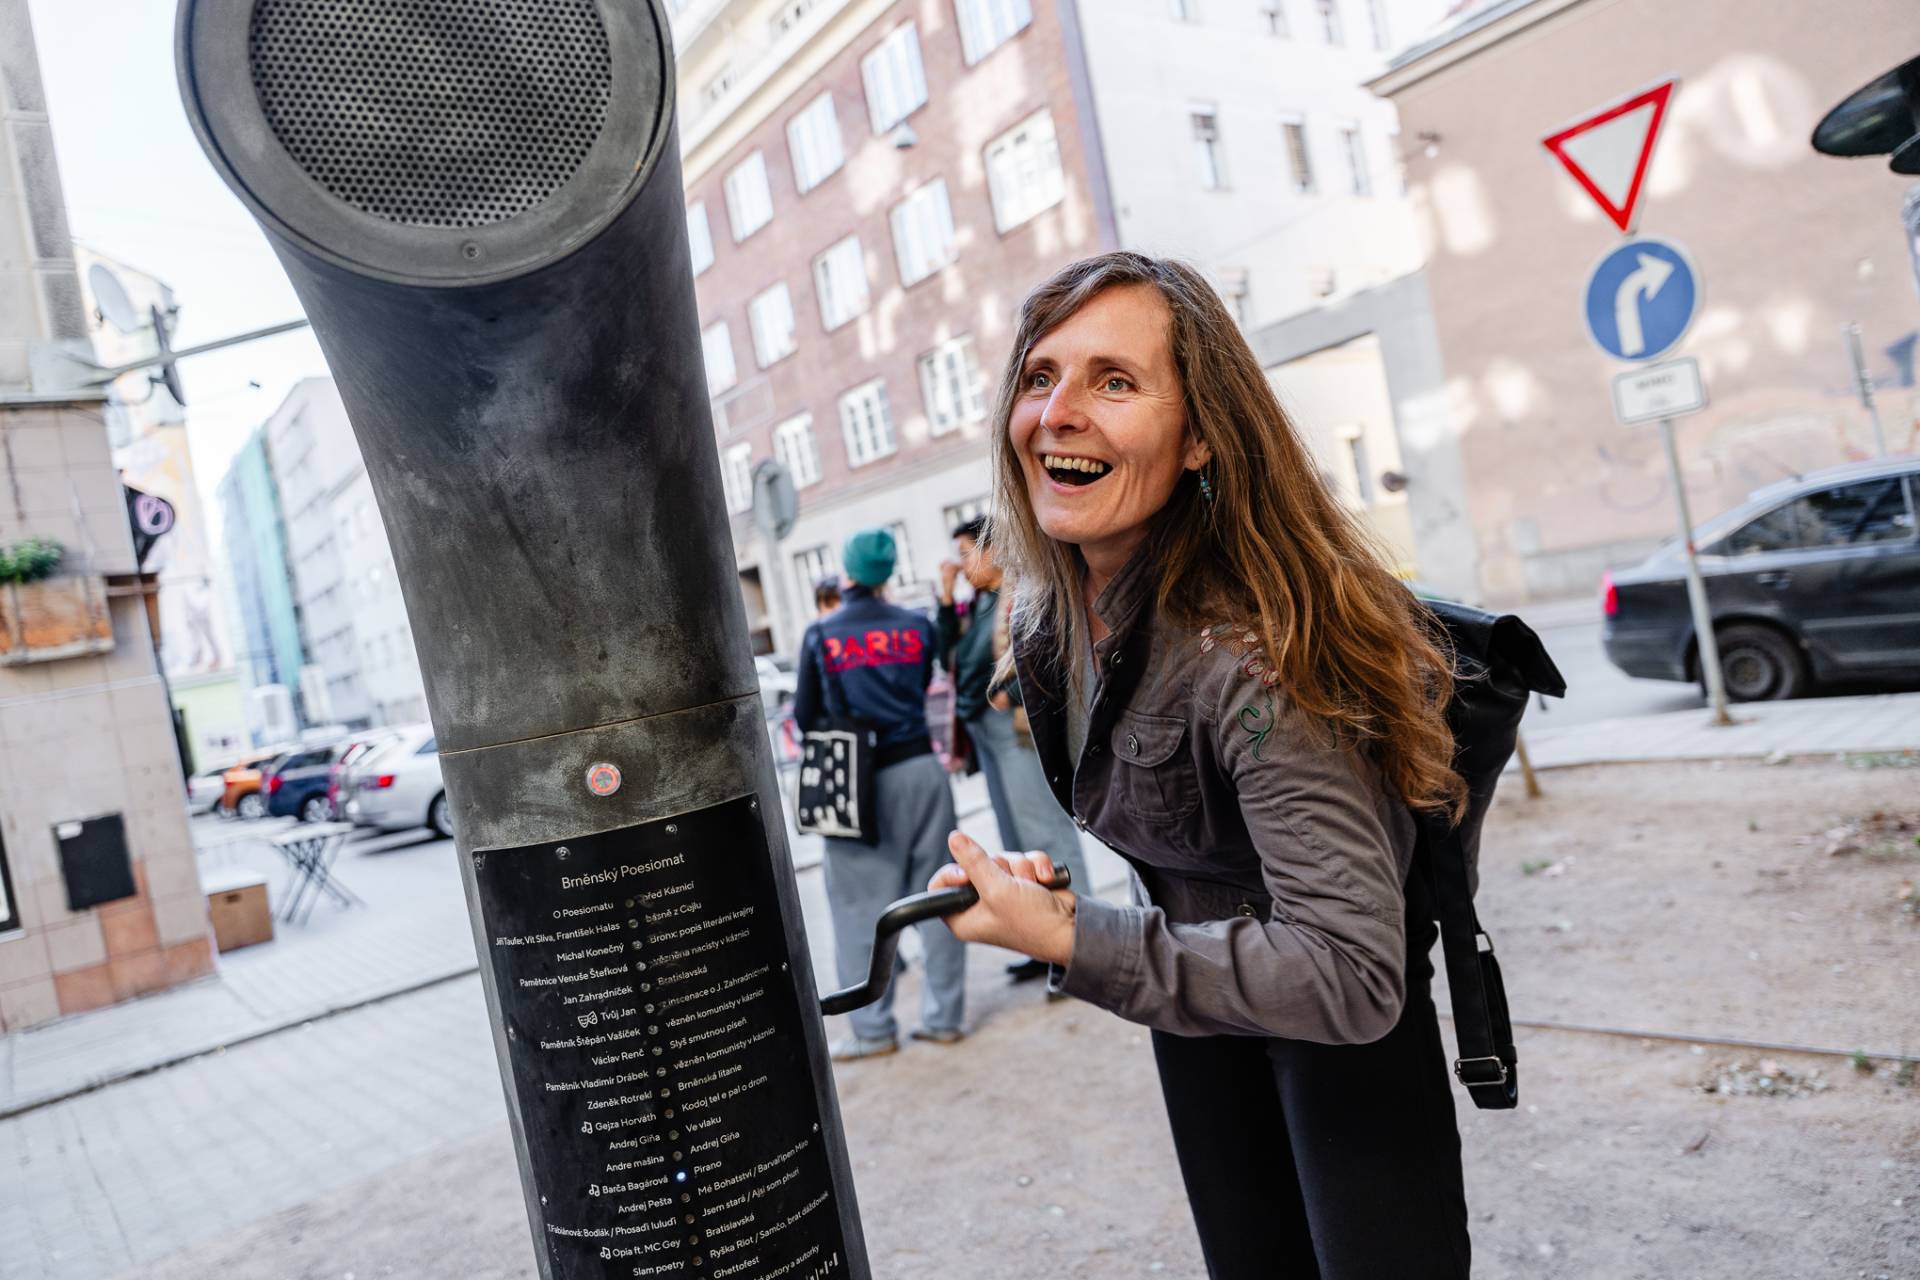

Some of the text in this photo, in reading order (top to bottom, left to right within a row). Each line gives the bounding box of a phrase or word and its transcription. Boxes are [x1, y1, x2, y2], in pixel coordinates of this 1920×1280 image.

[824, 627, 923, 662] PARIS
[562, 852, 685, 889] Brněnský Poesiomat
[553, 902, 614, 919] O Poesiomatu
[673, 907, 679, 916] z
[679, 923, 702, 938] popis
[702, 913, 732, 929] literární
[732, 904, 755, 920] krajiny
[556, 926, 595, 941] František
[595, 922, 621, 934] Halas
[557, 942, 625, 962] Michal Konečný
[691, 938, 720, 956] nacisty
[720, 937, 725, 945] v
[520, 963, 629, 988] Pamětnice Venuše Štefková
[657, 964, 708, 986] Bratislavská
[563, 985, 633, 1006] Jan Zahradníček
[709, 986, 716, 994] o
[715, 983, 723, 993] J.
[600, 1008, 637, 1023] Tvůj Jan
[666, 1014, 696, 1029] vězněn
[696, 999, 736, 1018] komunisty
[736, 998, 742, 1006] v
[540, 1028, 641, 1050] Pamětník Štěpán Vašíček
[669, 1016, 748, 1050] Slyš smutnou píseň
[592, 1048, 645, 1066] Václav Renč
[673, 1055, 706, 1071] vězněn
[706, 1040, 747, 1060] komunisty
[747, 1037, 753, 1045] v
[545, 1070, 649, 1092] Pamětník Vladimír Drábek
[677, 1063, 743, 1092] Brněnská litanie
[587, 1090, 653, 1110] Zdeněk Rotrekl
[682, 1074, 768, 1113] Kodoj tel e pal o drom
[595, 1112, 657, 1132] Gejza Horváth
[685, 1115, 722, 1133] Ve vlaku
[609, 1133, 661, 1150] Andrej Giňa
[690, 1130, 741, 1155] Andrej Giňa
[606, 1155, 665, 1173] Andre mašina
[693, 1160, 722, 1175] Pirano
[602, 1174, 669, 1195] Barča Bagárová
[698, 1184, 713, 1196] Mé
[713, 1169, 753, 1191] Bohatství
[618, 1197, 673, 1214] Andrej Pešta
[702, 1202, 725, 1217] Jsem
[725, 1193, 747, 1209] stará
[766, 1179, 782, 1192] som
[583, 1228, 610, 1238] Bodlák
[706, 1212, 755, 1238] Bratislavská
[709, 1243, 735, 1259] Ryška
[736, 1236, 754, 1250] Riot
[787, 1211, 802, 1225] brat
[612, 1239, 681, 1259] Opia ft. MC Gey
[633, 1260, 685, 1277] Slam poetry
[713, 1255, 760, 1279] Ghettofest
[765, 1264, 790, 1280] autory
[796, 1244, 819, 1265] autorky
